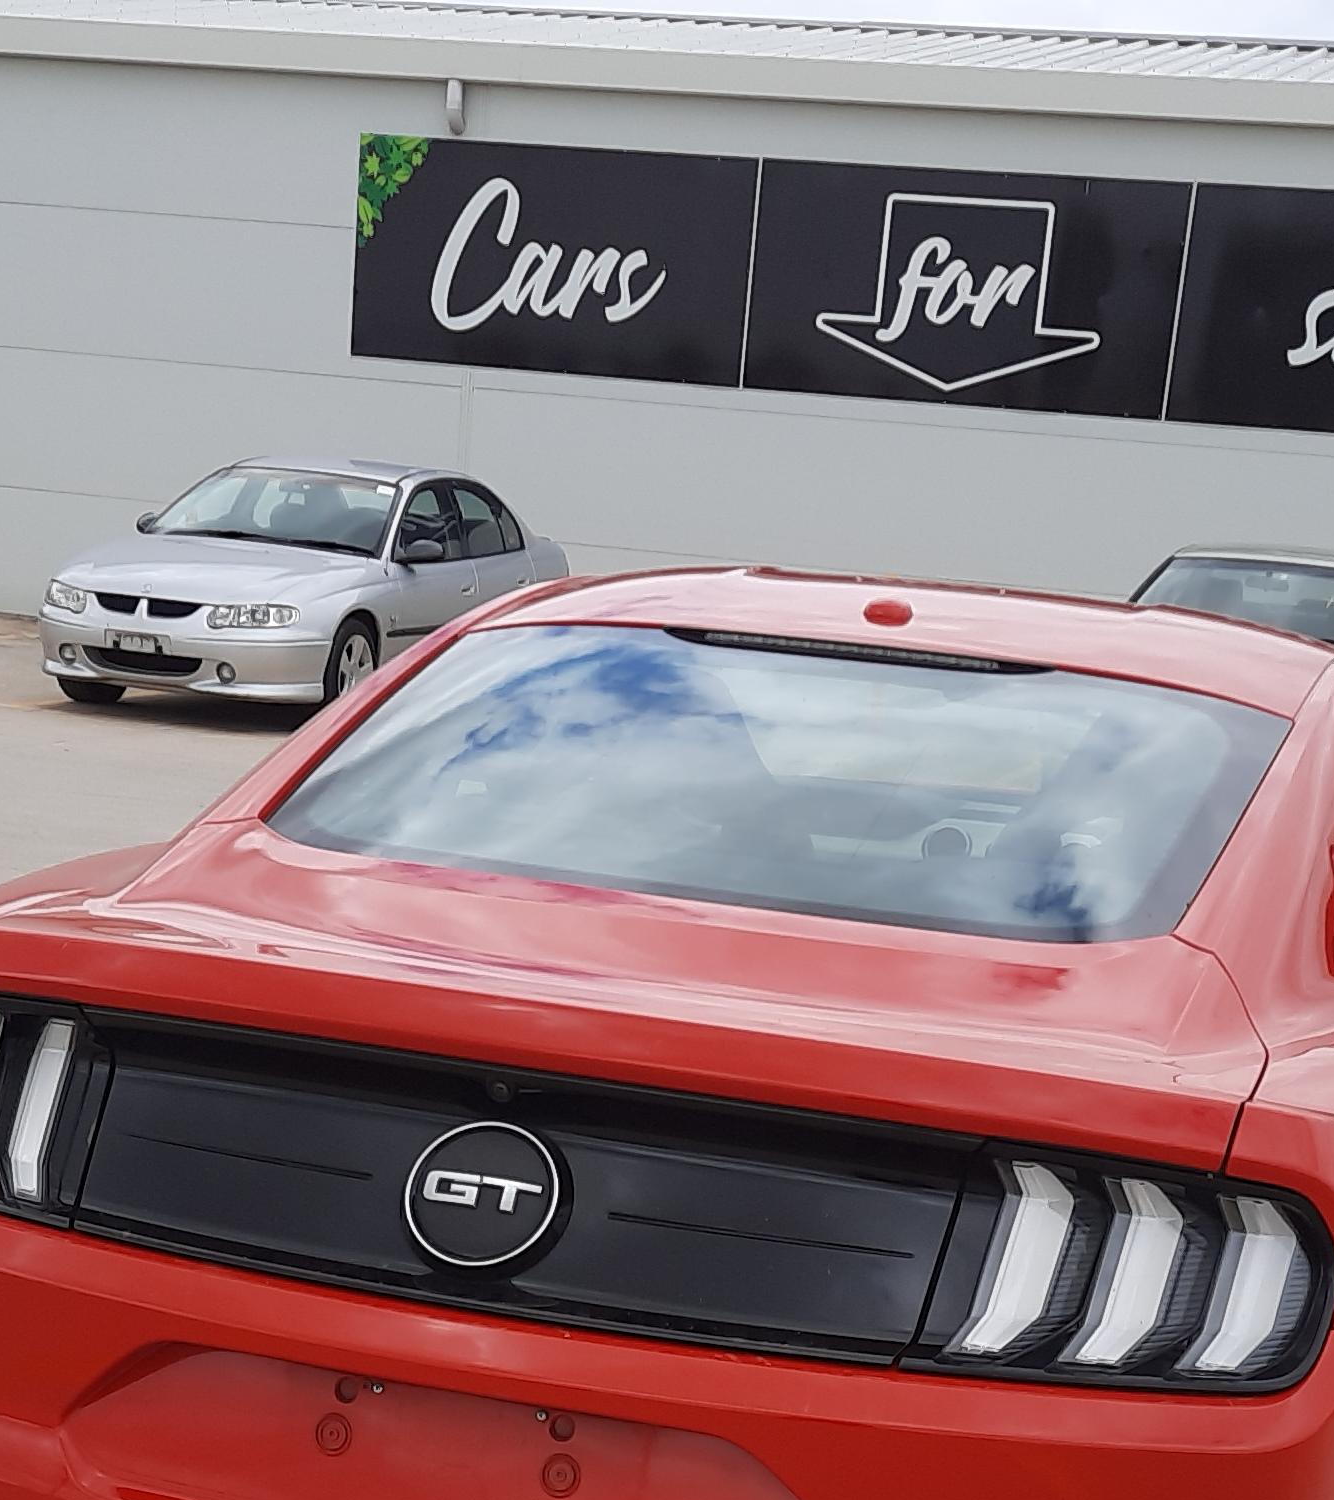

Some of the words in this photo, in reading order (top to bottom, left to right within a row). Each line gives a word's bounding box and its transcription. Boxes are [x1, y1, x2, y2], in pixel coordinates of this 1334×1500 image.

[431, 177, 666, 331] Cars
[875, 236, 1037, 342] for
[423, 1169, 544, 1214] GT
